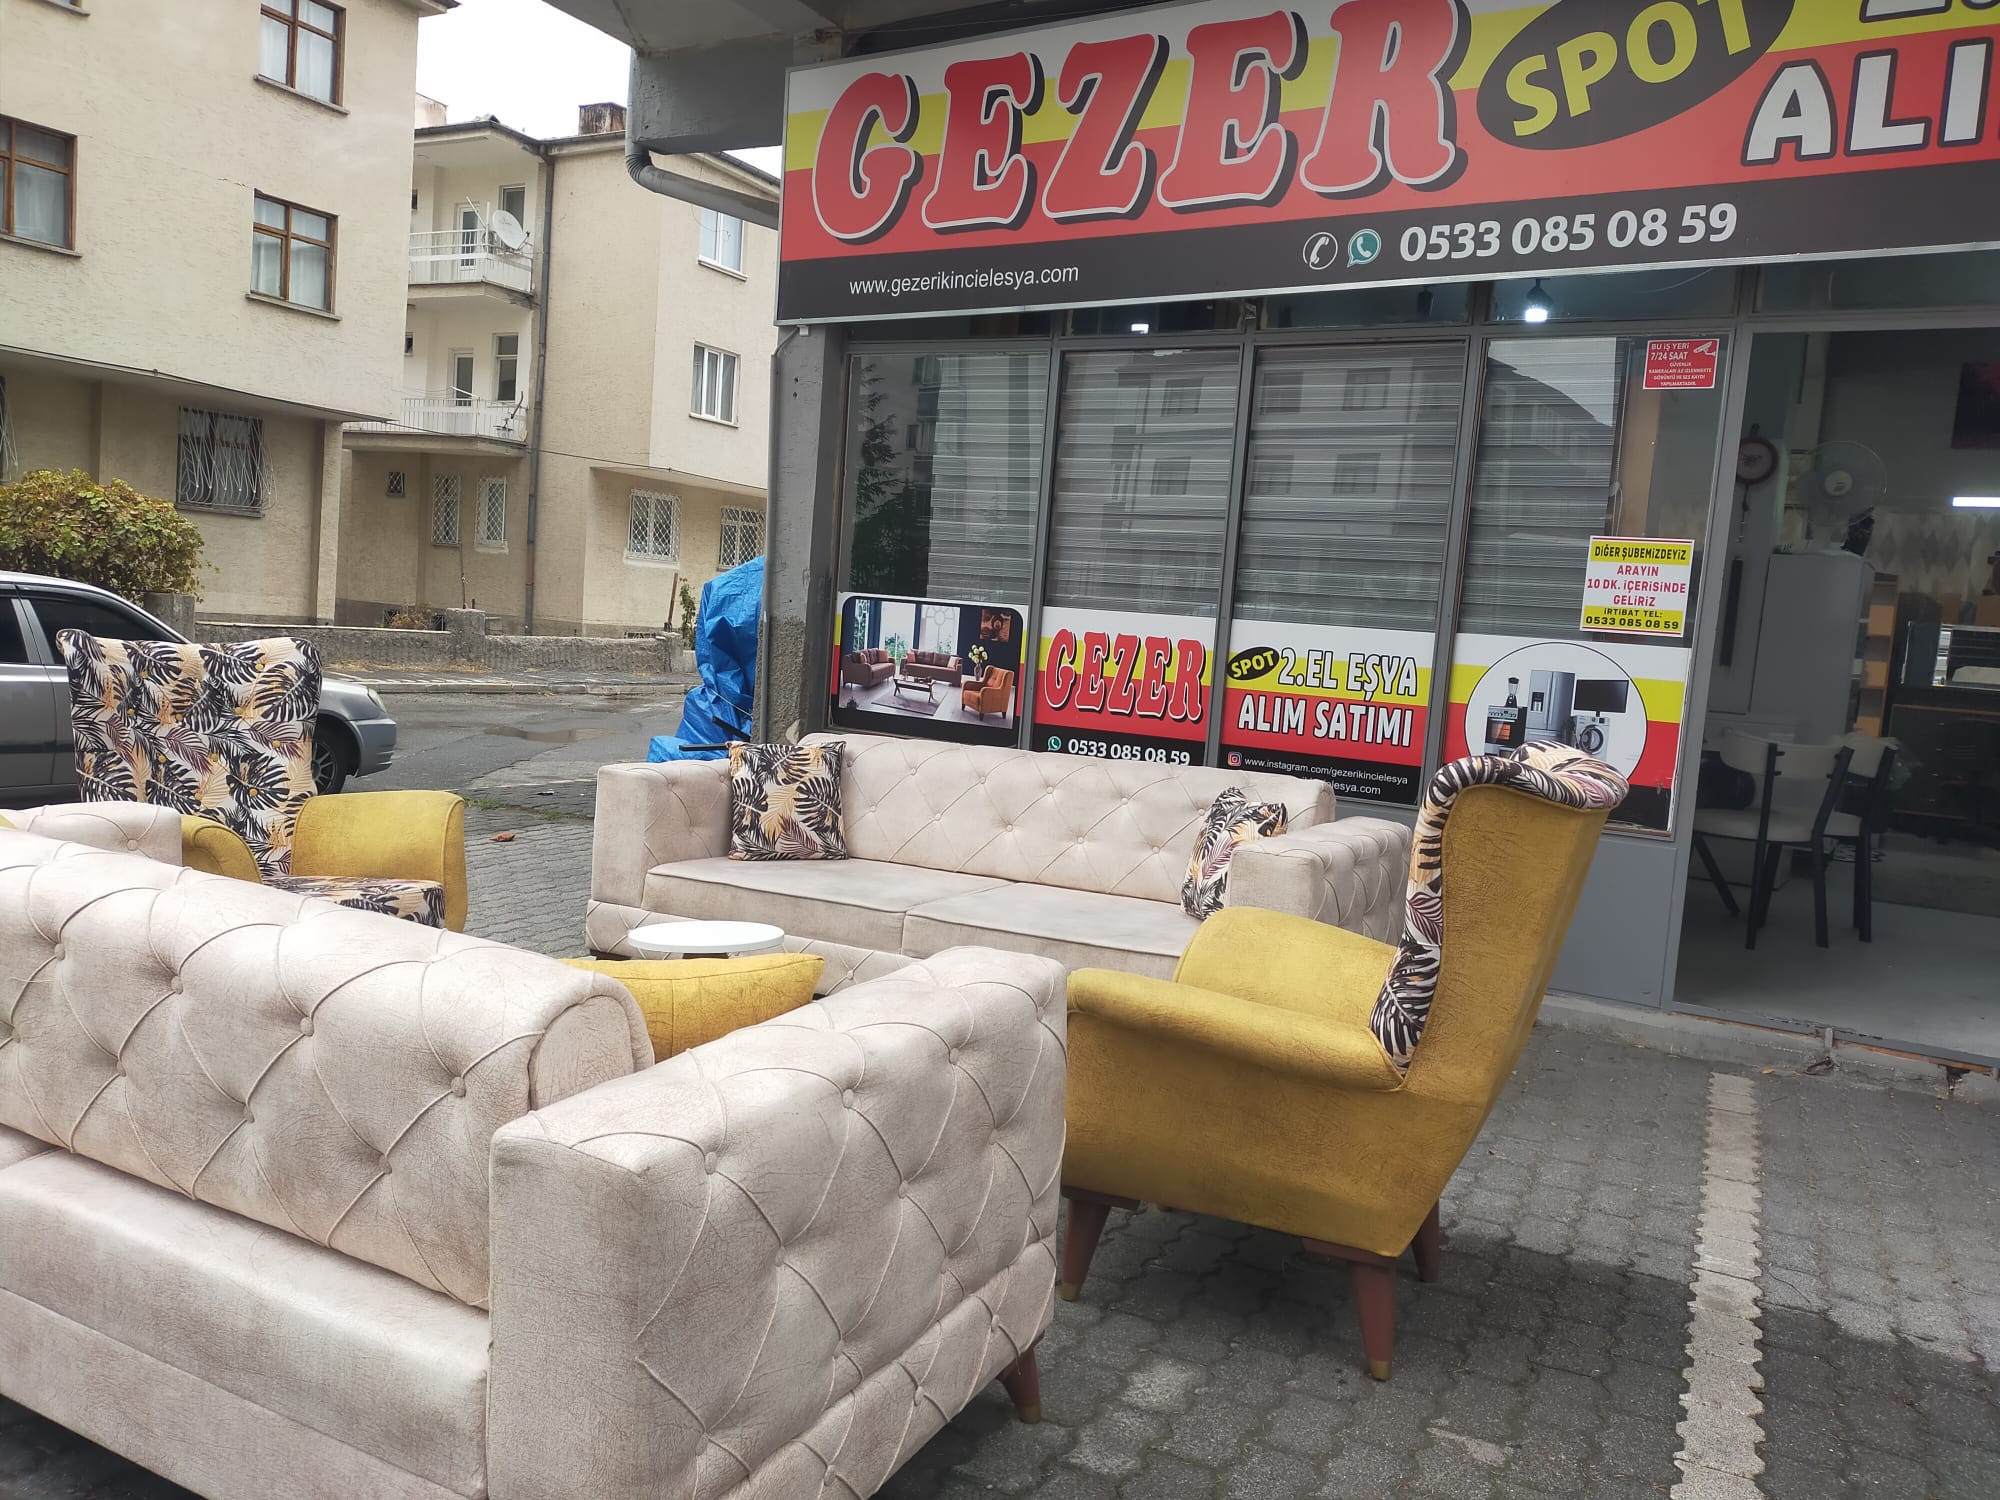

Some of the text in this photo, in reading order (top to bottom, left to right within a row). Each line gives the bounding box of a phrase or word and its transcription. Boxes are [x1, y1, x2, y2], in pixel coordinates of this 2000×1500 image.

[1505, 0, 1752, 137] SPOT
[1741, 36, 2000, 166] ALI
[811, 0, 1467, 245] GEZER
[1400, 203, 1737, 262] 0533 085 08 59
[849, 265, 1079, 297] www.gezerikincielesya.com
[1650, 351, 1688, 361] 7/24 SAAT
[1587, 578, 1600, 589] 10
[1603, 579, 1621, 590] DK.
[1617, 565, 1659, 576] ARAYIN
[1586, 616, 1679, 629] 0533 085 08 59
[1643, 610, 1663, 618] TEL:
[1045, 628, 1206, 723] GEZER
[1231, 650, 1275, 678] SPOT
[1278, 647, 1417, 702] 2.EL EŞYA
[1237, 693, 1414, 748] ALIM SATIMI
[1068, 738, 1190, 766] 0533 085 08 59
[1244, 756, 1408, 786] www.instagram.com/gezerikincielesya
